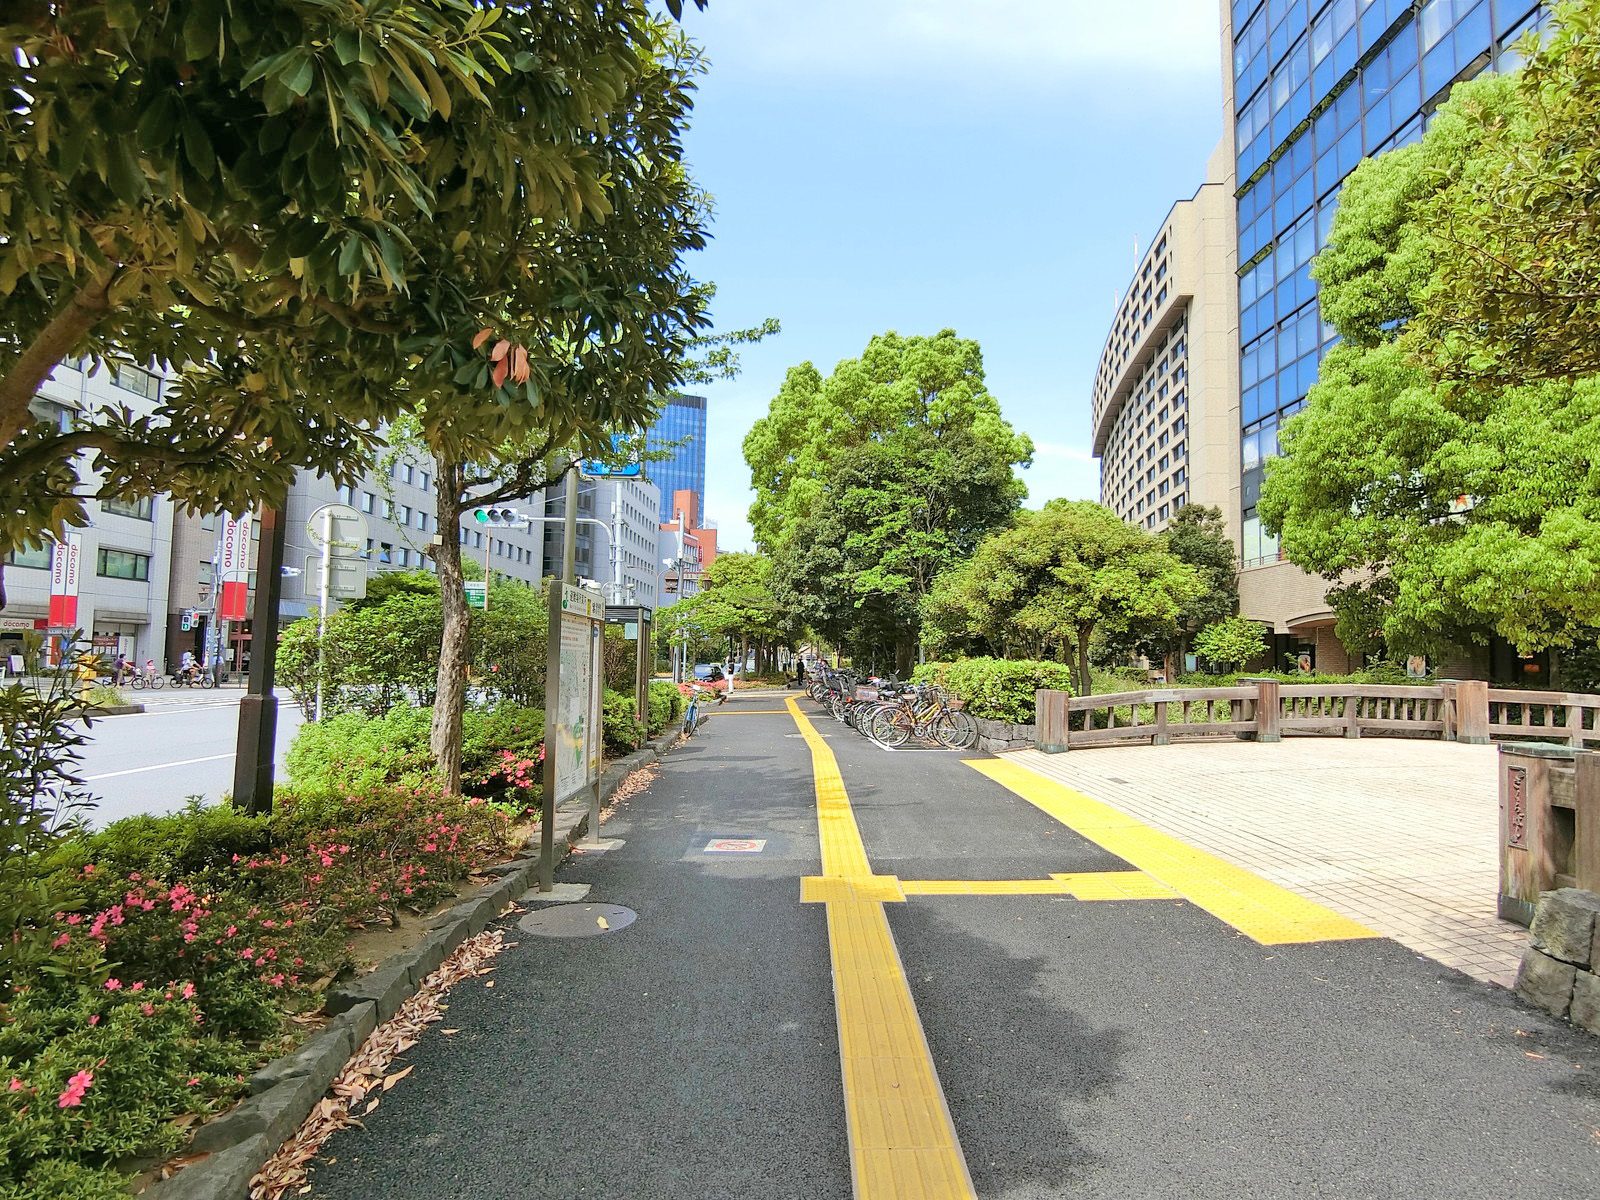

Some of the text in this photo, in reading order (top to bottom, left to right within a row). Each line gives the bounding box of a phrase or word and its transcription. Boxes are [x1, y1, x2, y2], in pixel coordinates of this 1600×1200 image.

[55, 544, 65, 584] docomo
[69, 544, 78, 585] docomo
[225, 520, 237, 568] docomo
[240, 521, 249, 569] docomo
[3, 620, 30, 628] docomo
